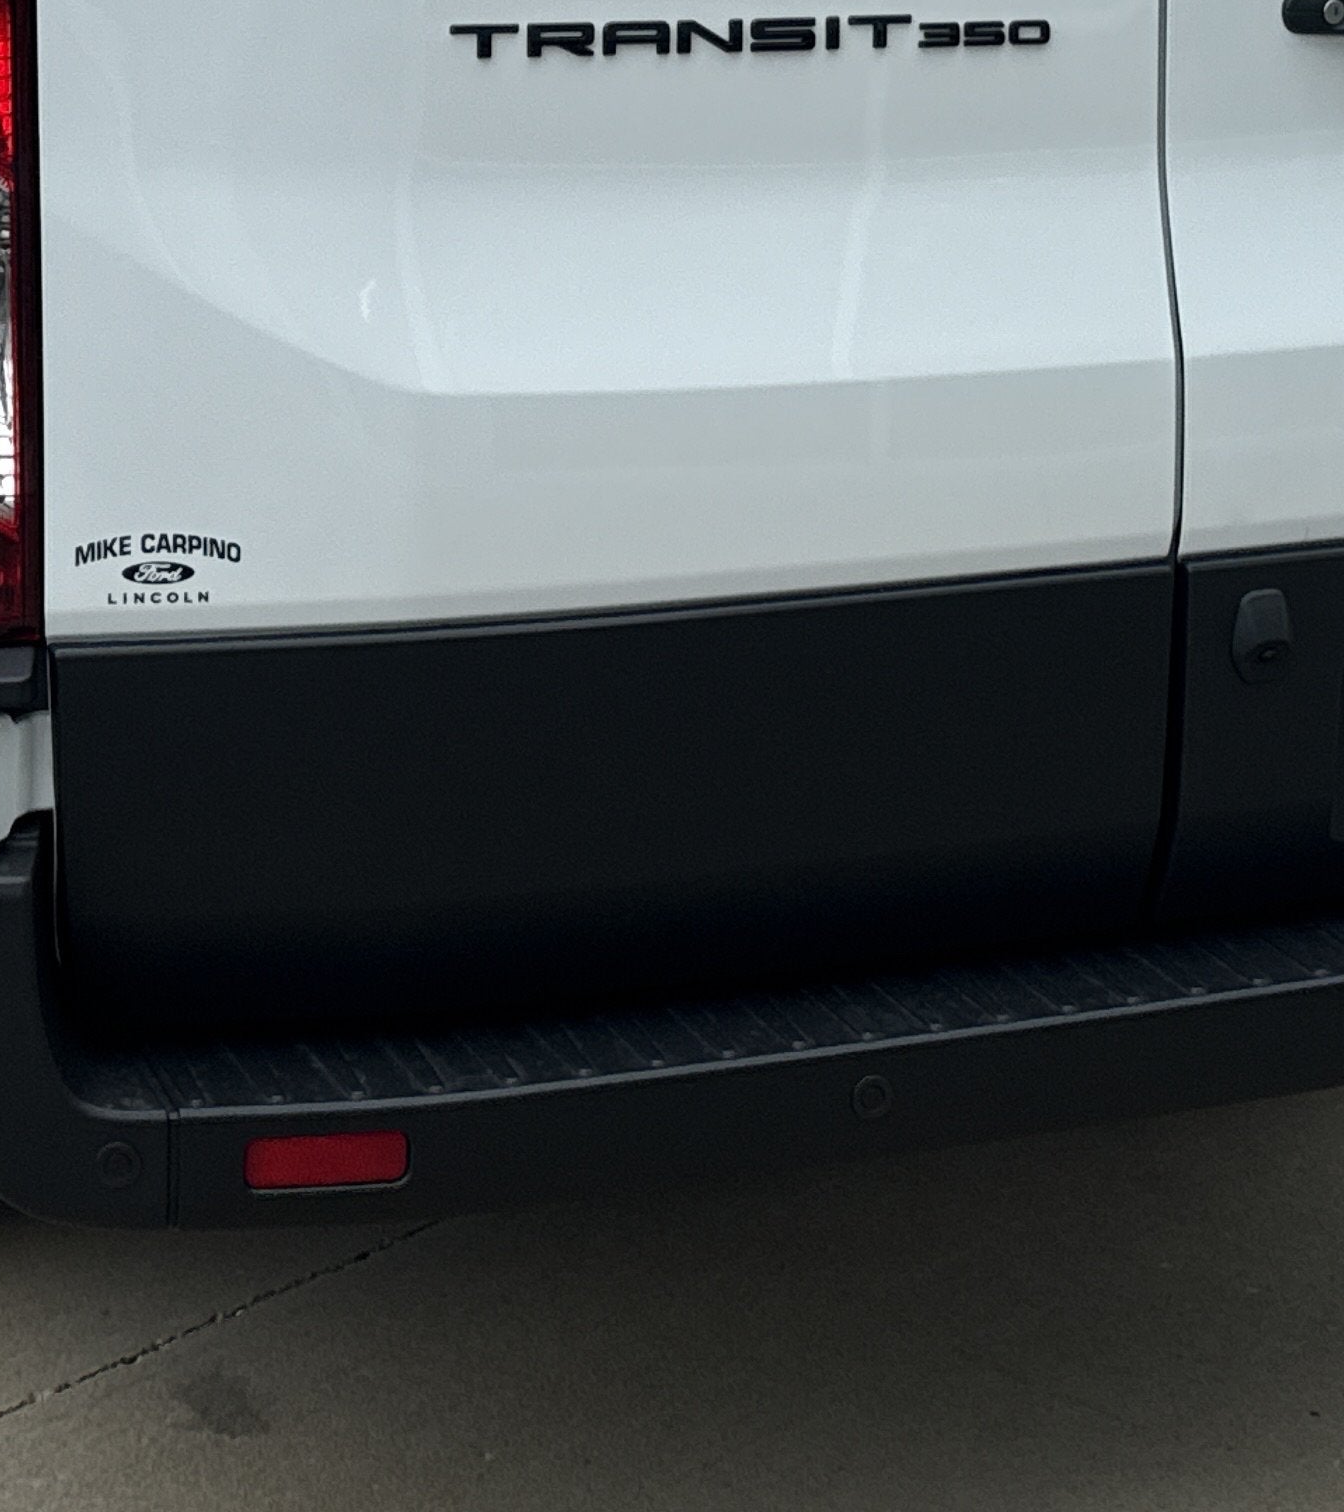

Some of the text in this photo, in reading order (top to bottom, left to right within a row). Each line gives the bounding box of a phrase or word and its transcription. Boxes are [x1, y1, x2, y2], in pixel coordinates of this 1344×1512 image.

[449, 13, 1050, 59] TRANSIT 350
[74, 533, 241, 567] MIKE CARPINO
[133, 563, 184, 582] Ford
[107, 591, 210, 605] LINCOLN
